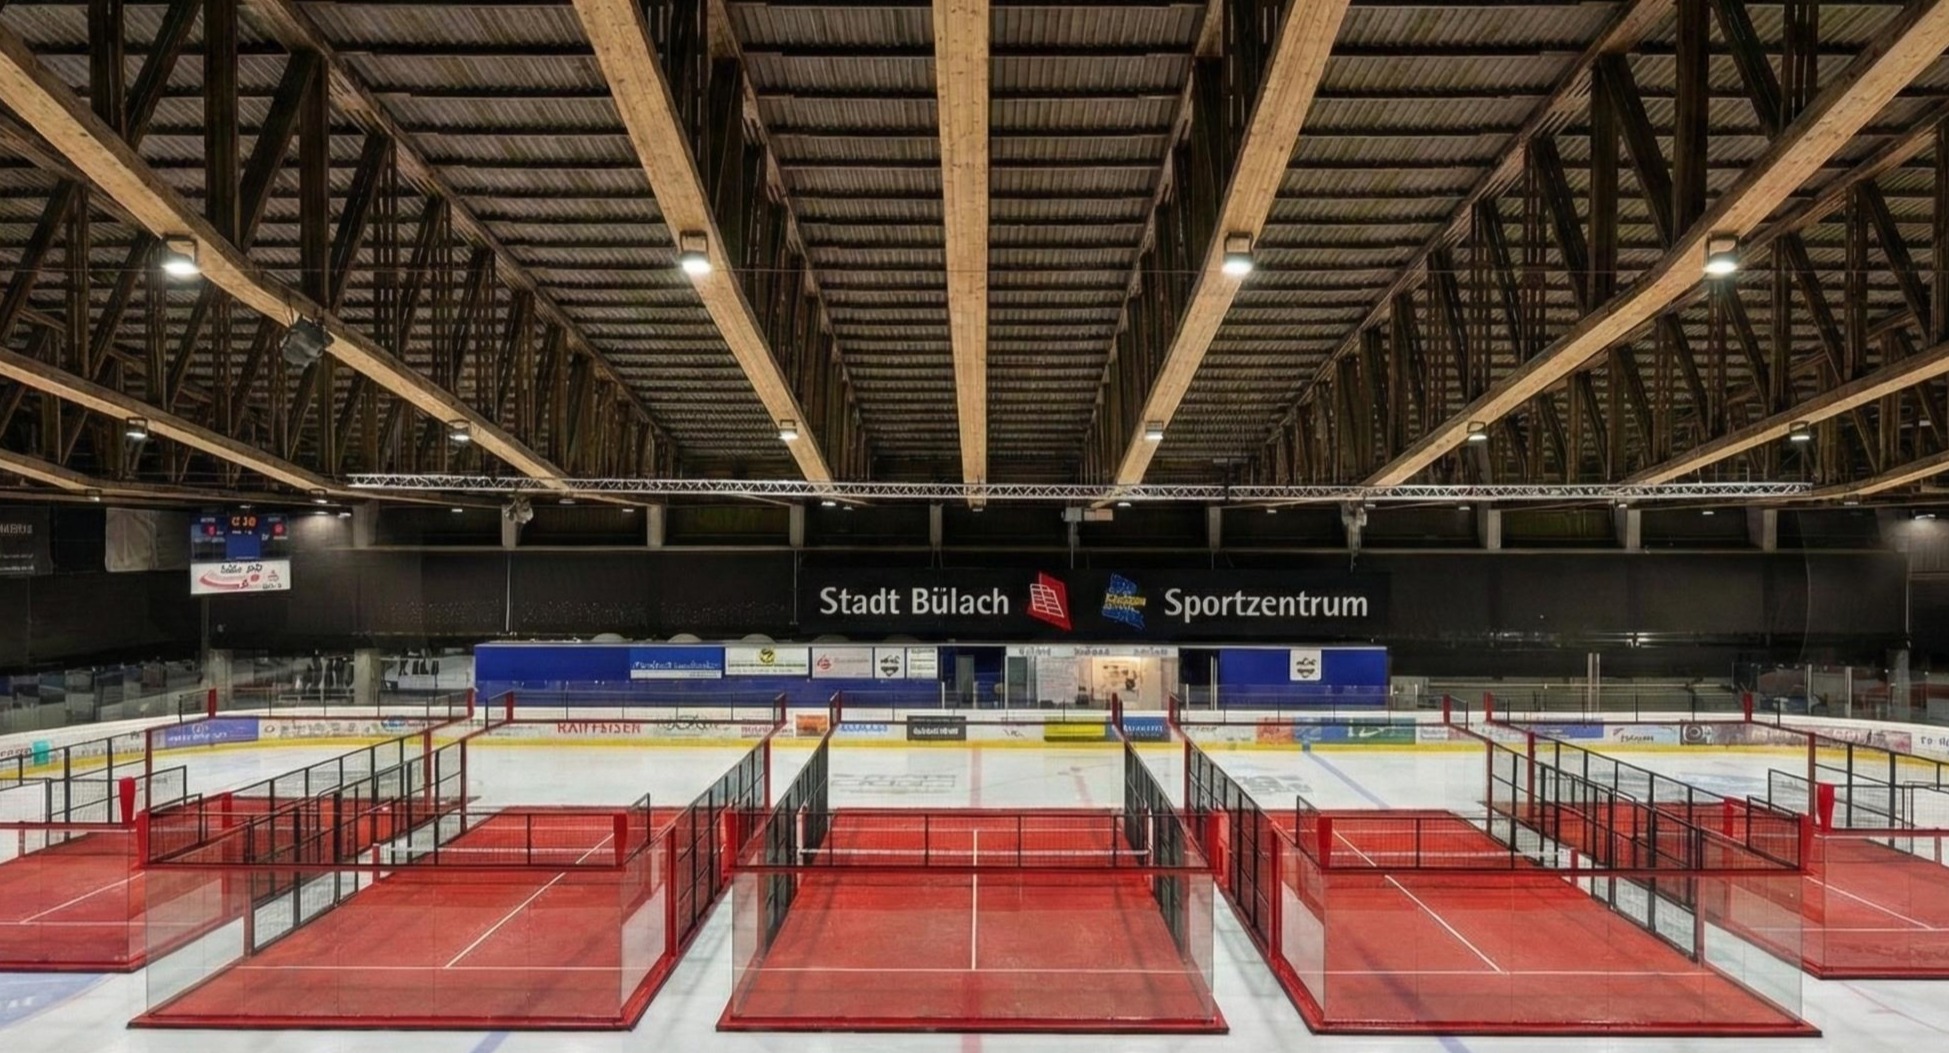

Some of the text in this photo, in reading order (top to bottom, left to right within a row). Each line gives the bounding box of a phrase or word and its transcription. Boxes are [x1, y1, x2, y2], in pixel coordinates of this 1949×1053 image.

[820, 586, 1009, 615] Stadt Bülach
[1164, 588, 1368, 624] Sportzentrum
